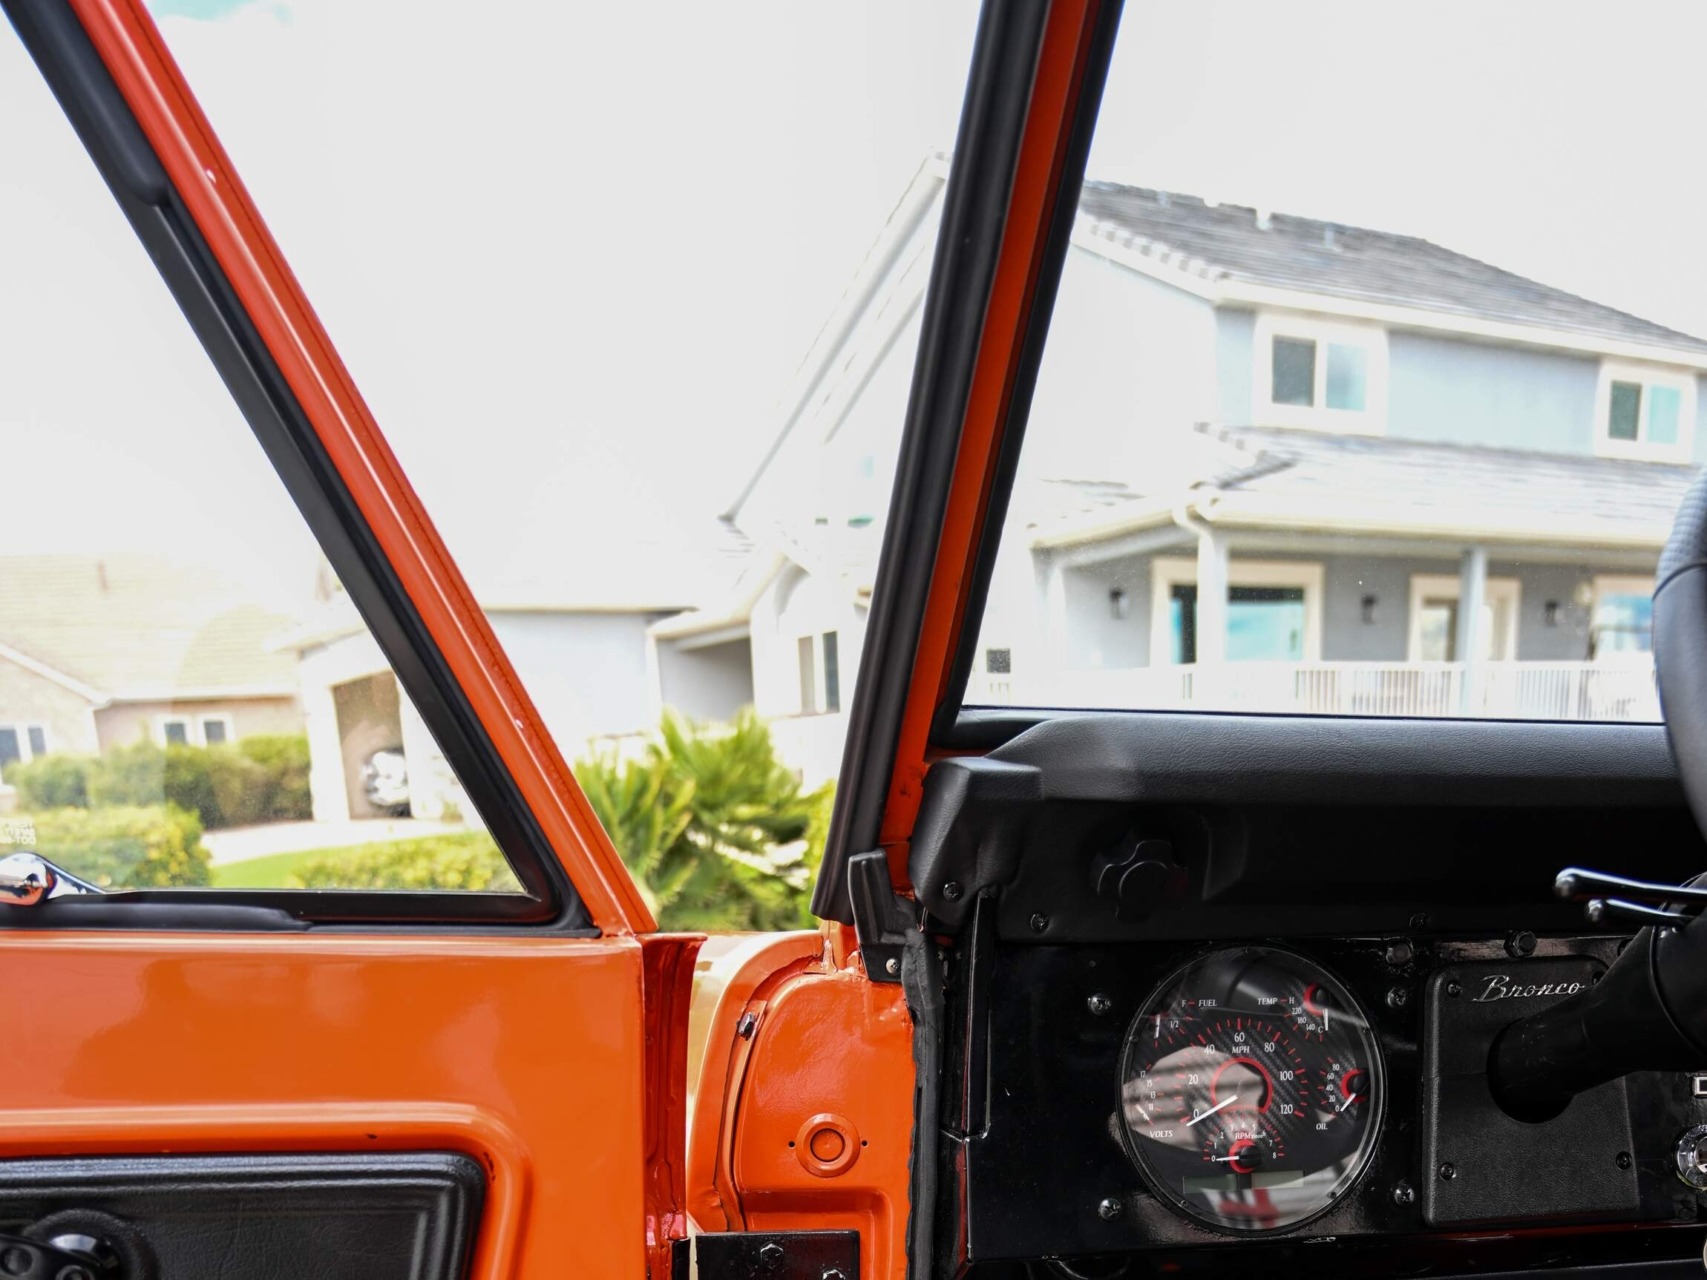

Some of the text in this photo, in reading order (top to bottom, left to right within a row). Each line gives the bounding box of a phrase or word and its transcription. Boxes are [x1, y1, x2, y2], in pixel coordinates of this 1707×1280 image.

[1472, 975, 1585, 1002] Bronco
[1289, 997, 1295, 1005] H
[1292, 1007, 1302, 1015] 220
[1234, 1032, 1245, 1042] 60
[1204, 1044, 1215, 1054] 40
[1232, 1046, 1250, 1054] MPH
[1264, 1042, 1275, 1053] 80
[1188, 1074, 1199, 1085] 20
[1280, 1070, 1294, 1081] 100
[1193, 1108, 1200, 1119] 0
[1280, 1104, 1294, 1115] 120
[1149, 1130, 1173, 1138] VOLTS
[1235, 1132, 1251, 1140] RPM
